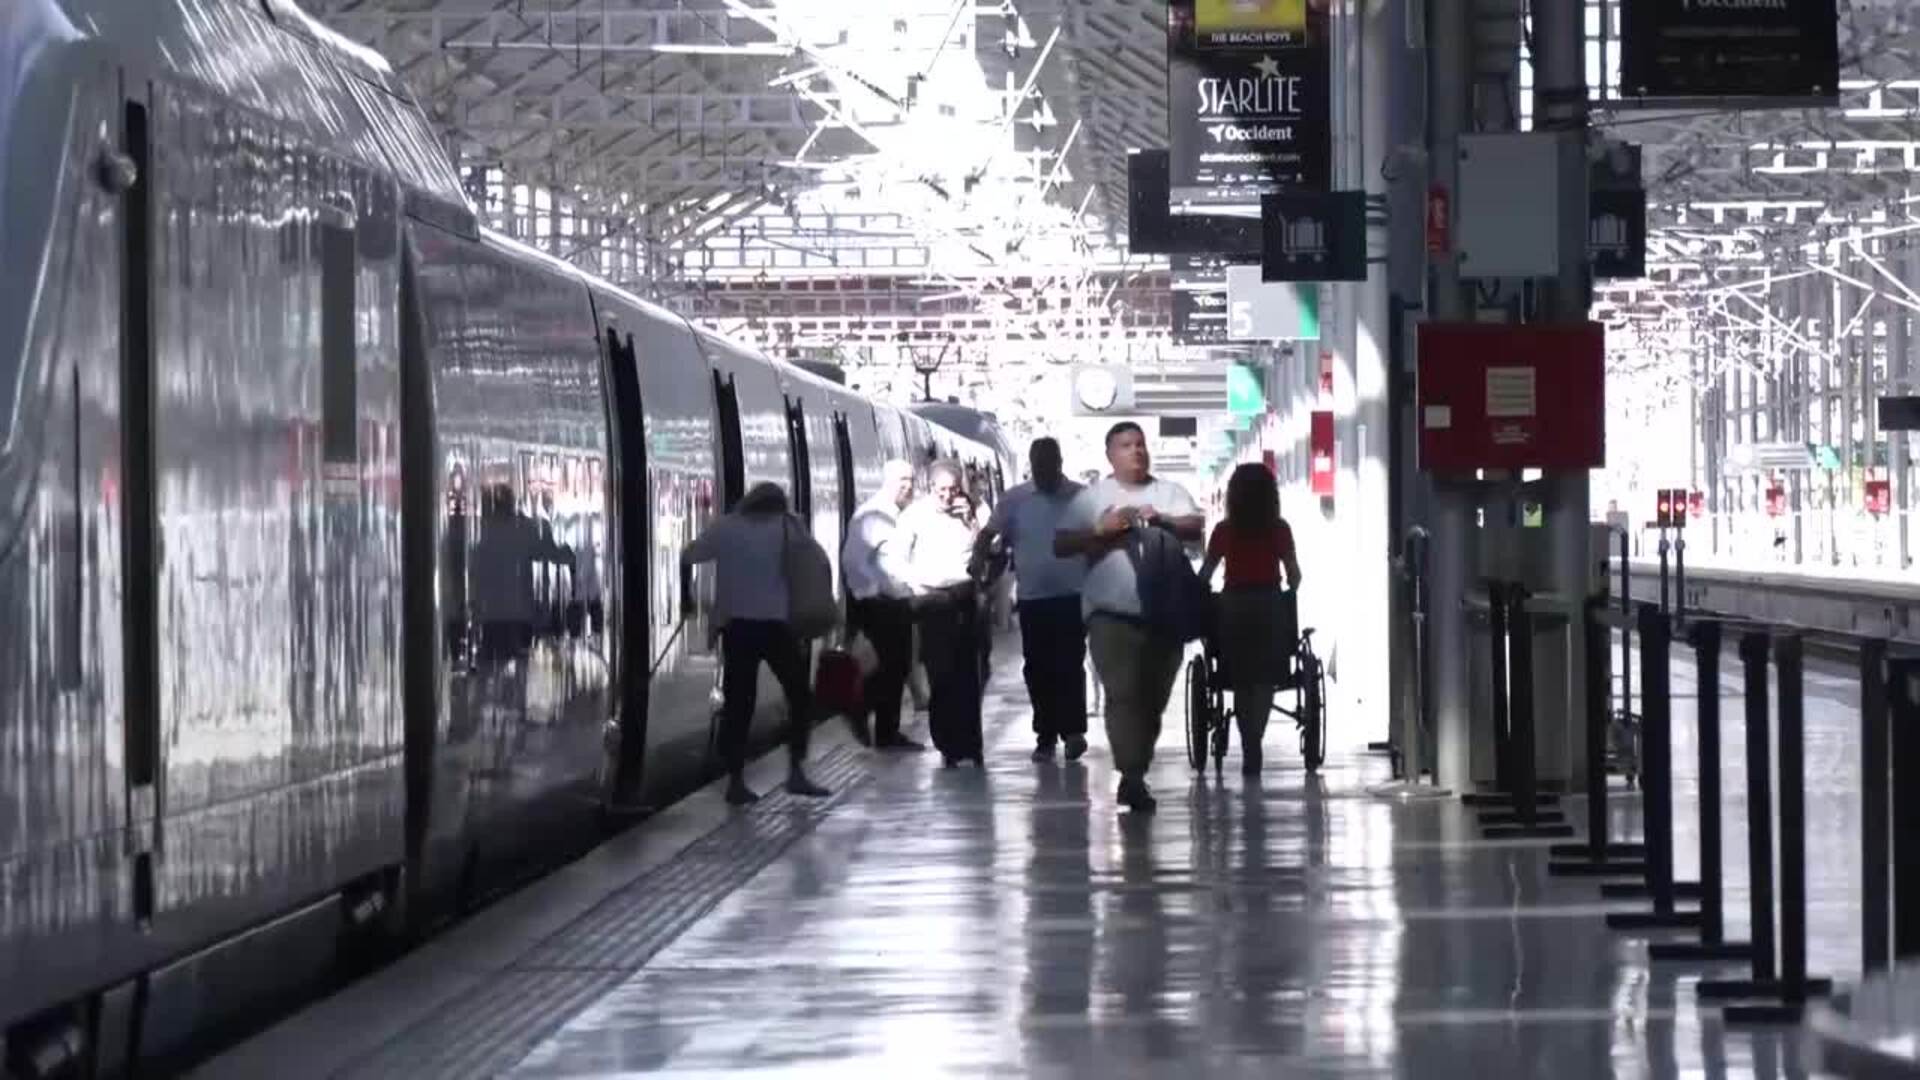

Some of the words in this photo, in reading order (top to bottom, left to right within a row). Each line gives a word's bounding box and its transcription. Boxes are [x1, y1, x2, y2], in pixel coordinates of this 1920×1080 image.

[1211, 32, 1227, 43] THE
[1229, 32, 1262, 43] BEACH
[1265, 32, 1291, 43] BOYS
[1197, 77, 1302, 114] STARLITE
[1225, 124, 1293, 140] Occident
[1231, 301, 1251, 337] 5
